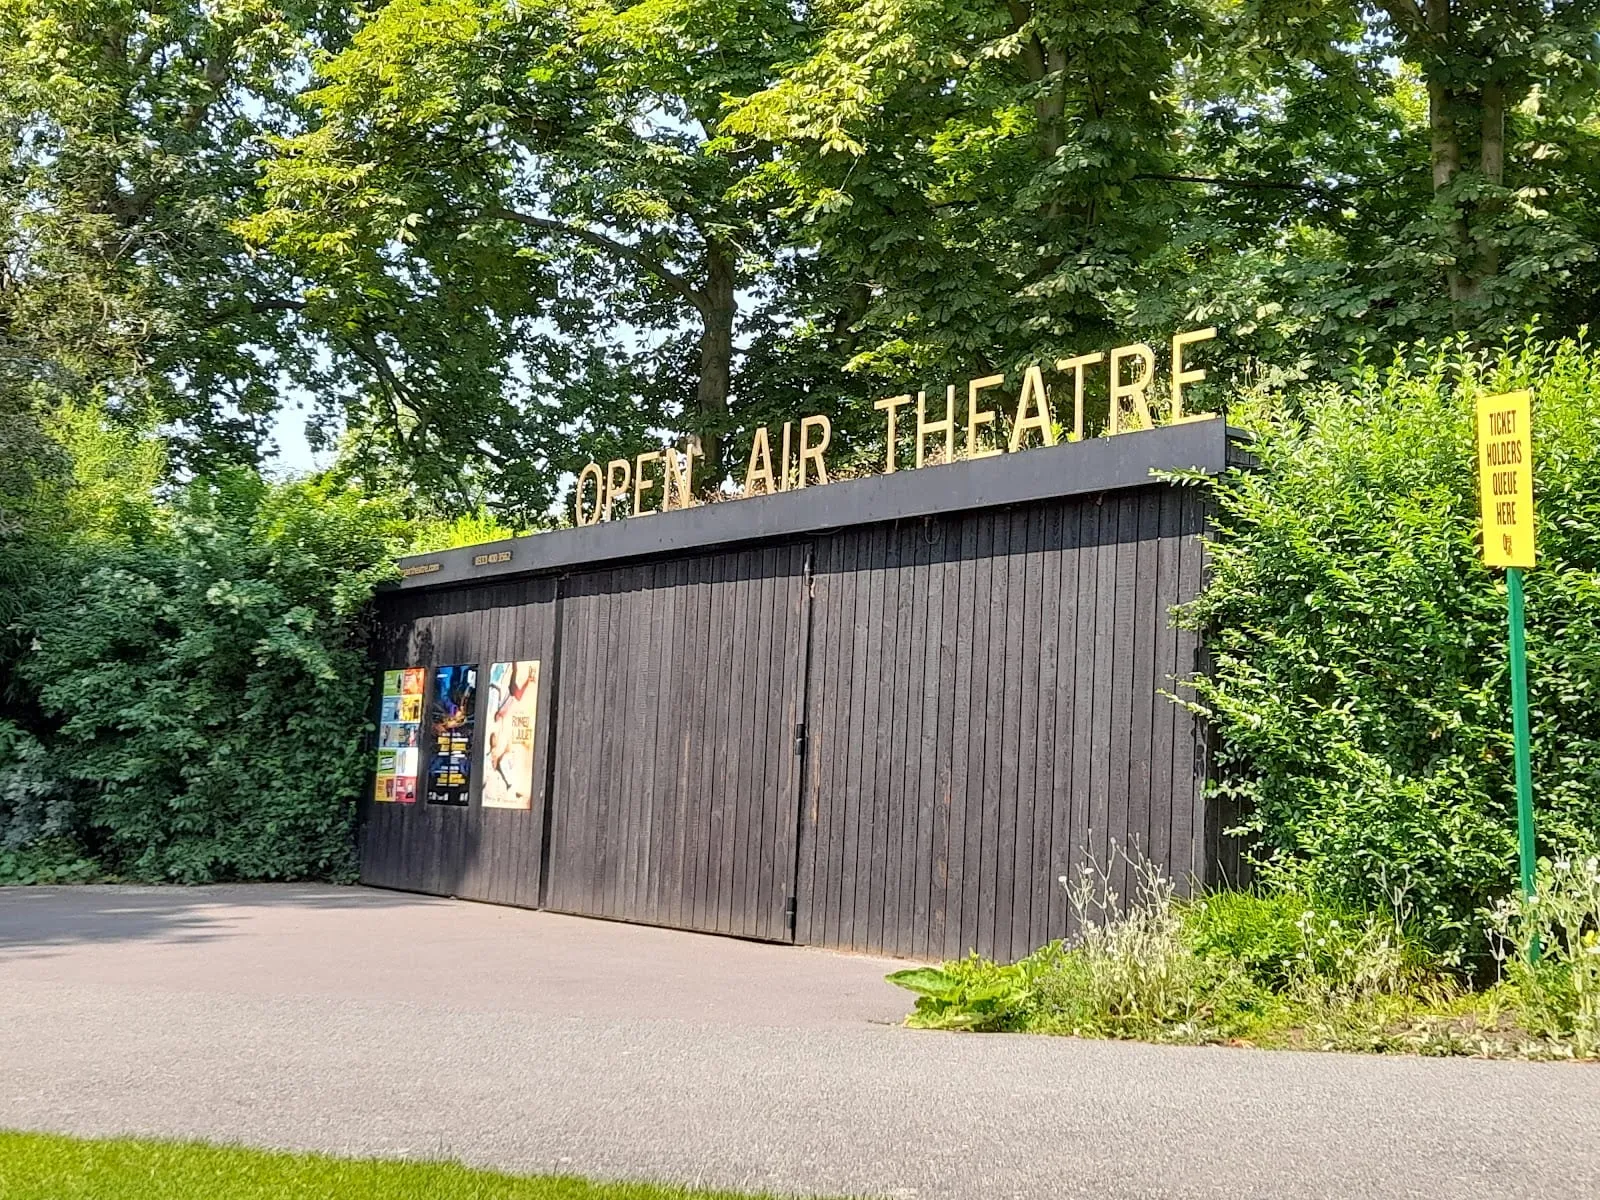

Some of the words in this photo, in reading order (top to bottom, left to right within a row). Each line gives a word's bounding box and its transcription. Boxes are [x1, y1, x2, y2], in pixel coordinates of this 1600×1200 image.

[575, 443, 694, 527] OPEN
[744, 414, 832, 498] AIR
[873, 327, 1218, 474] THEATRE
[1489, 409, 1517, 436] TICKET
[1486, 439, 1522, 467] HOLDERS
[1492, 470, 1518, 496] QUEUE
[1496, 501, 1517, 526] HERE
